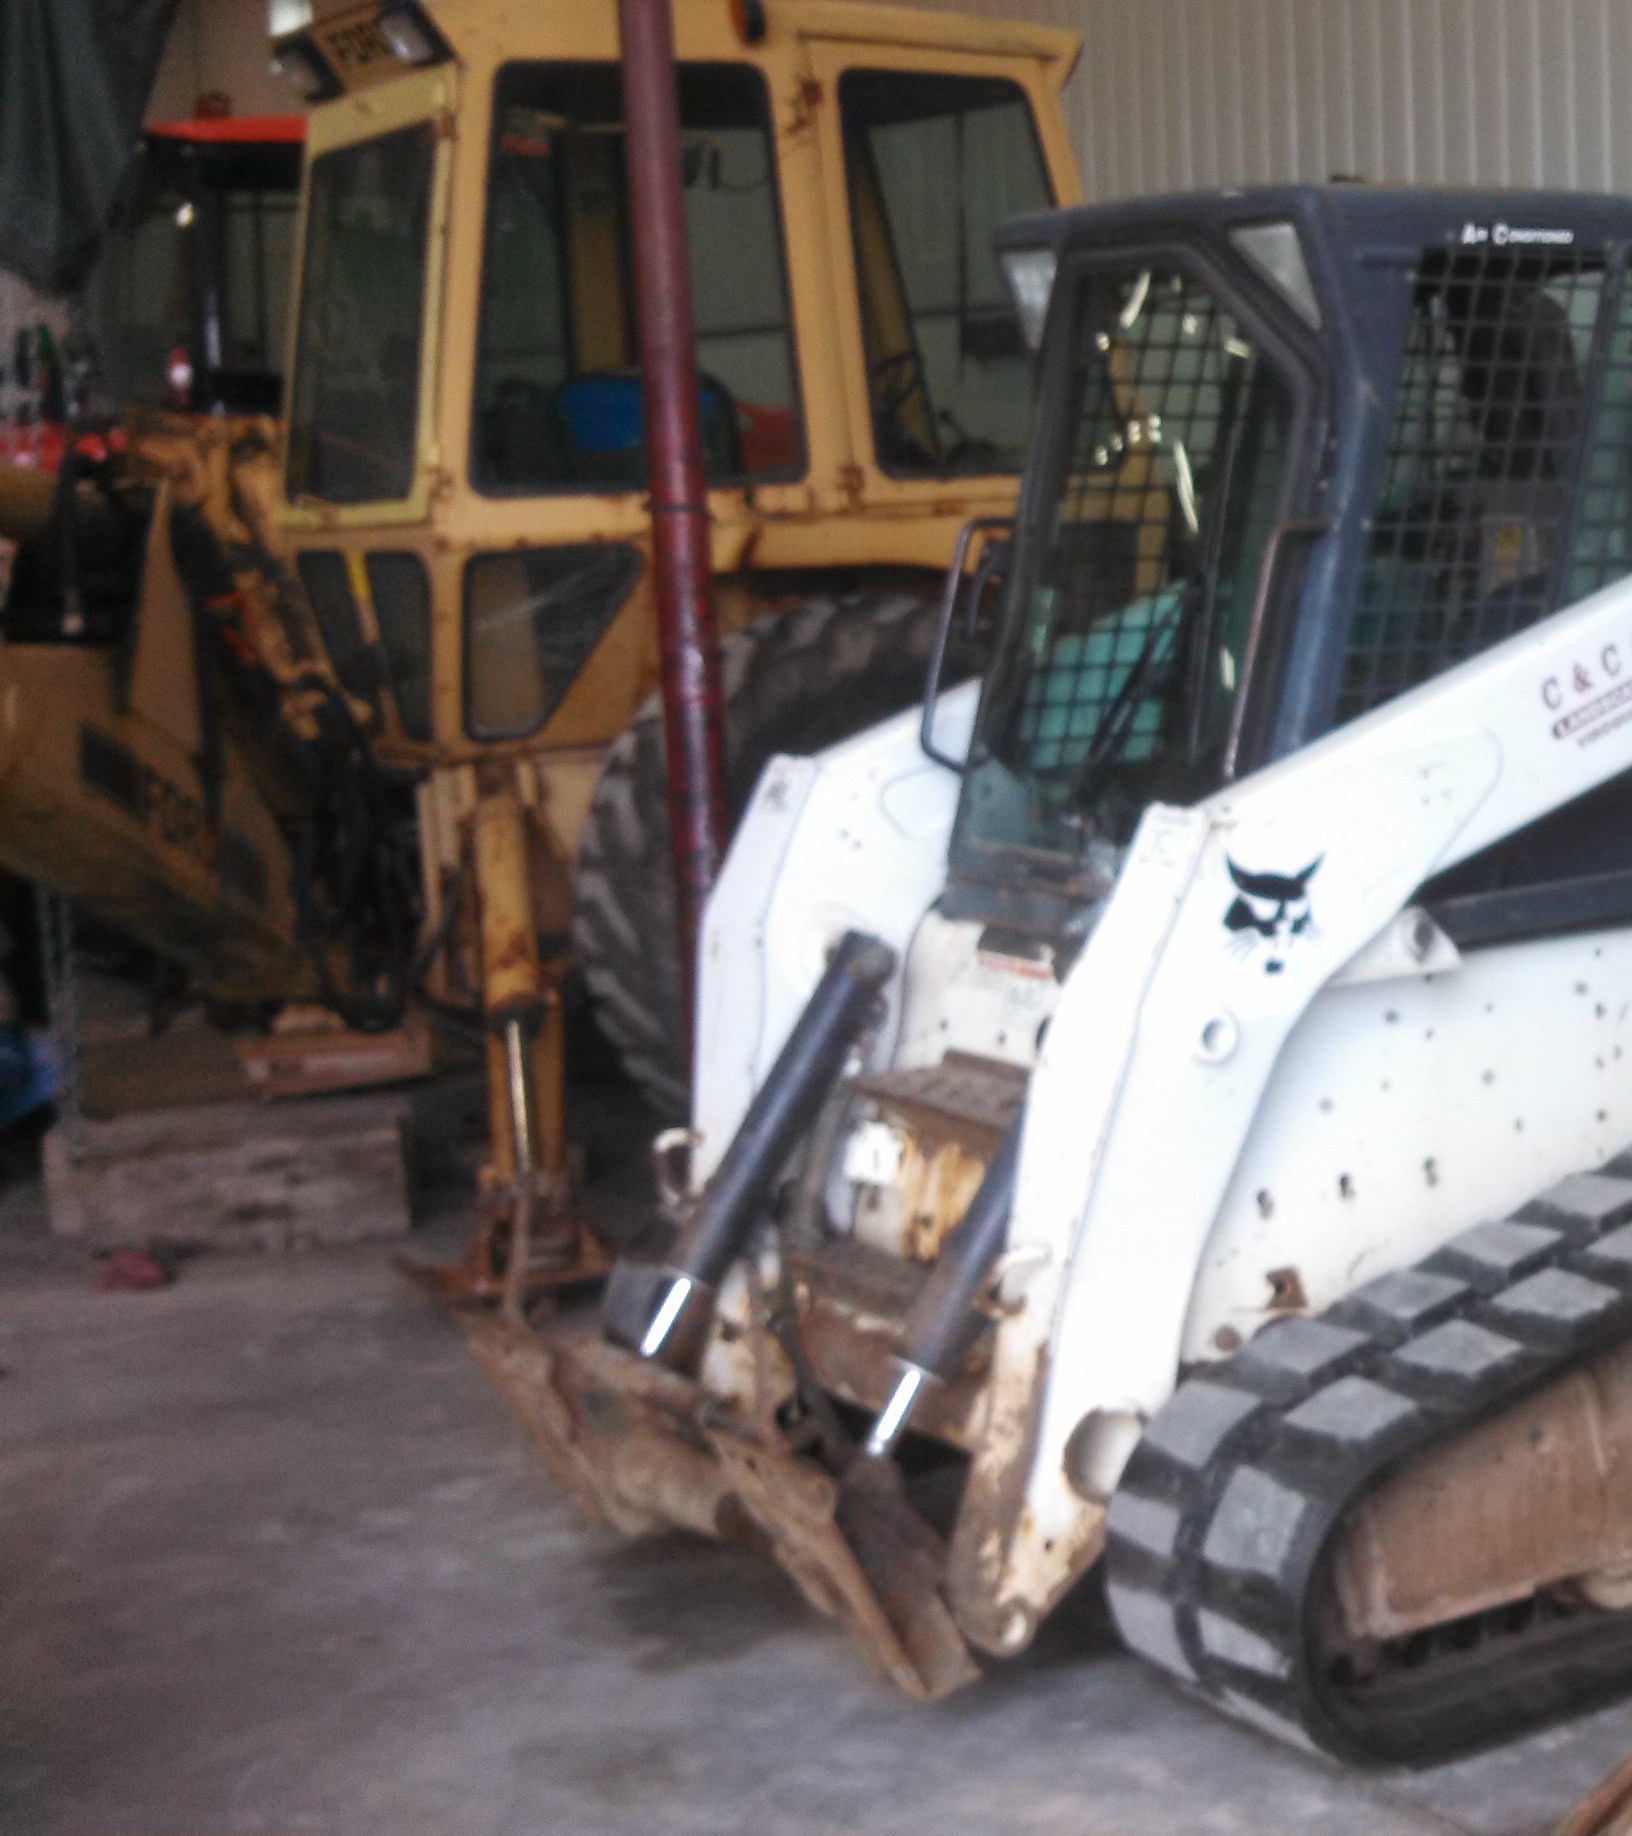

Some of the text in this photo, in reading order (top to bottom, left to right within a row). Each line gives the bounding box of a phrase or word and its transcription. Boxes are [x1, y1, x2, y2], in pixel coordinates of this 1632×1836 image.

[1542, 644, 1621, 710] C & C
